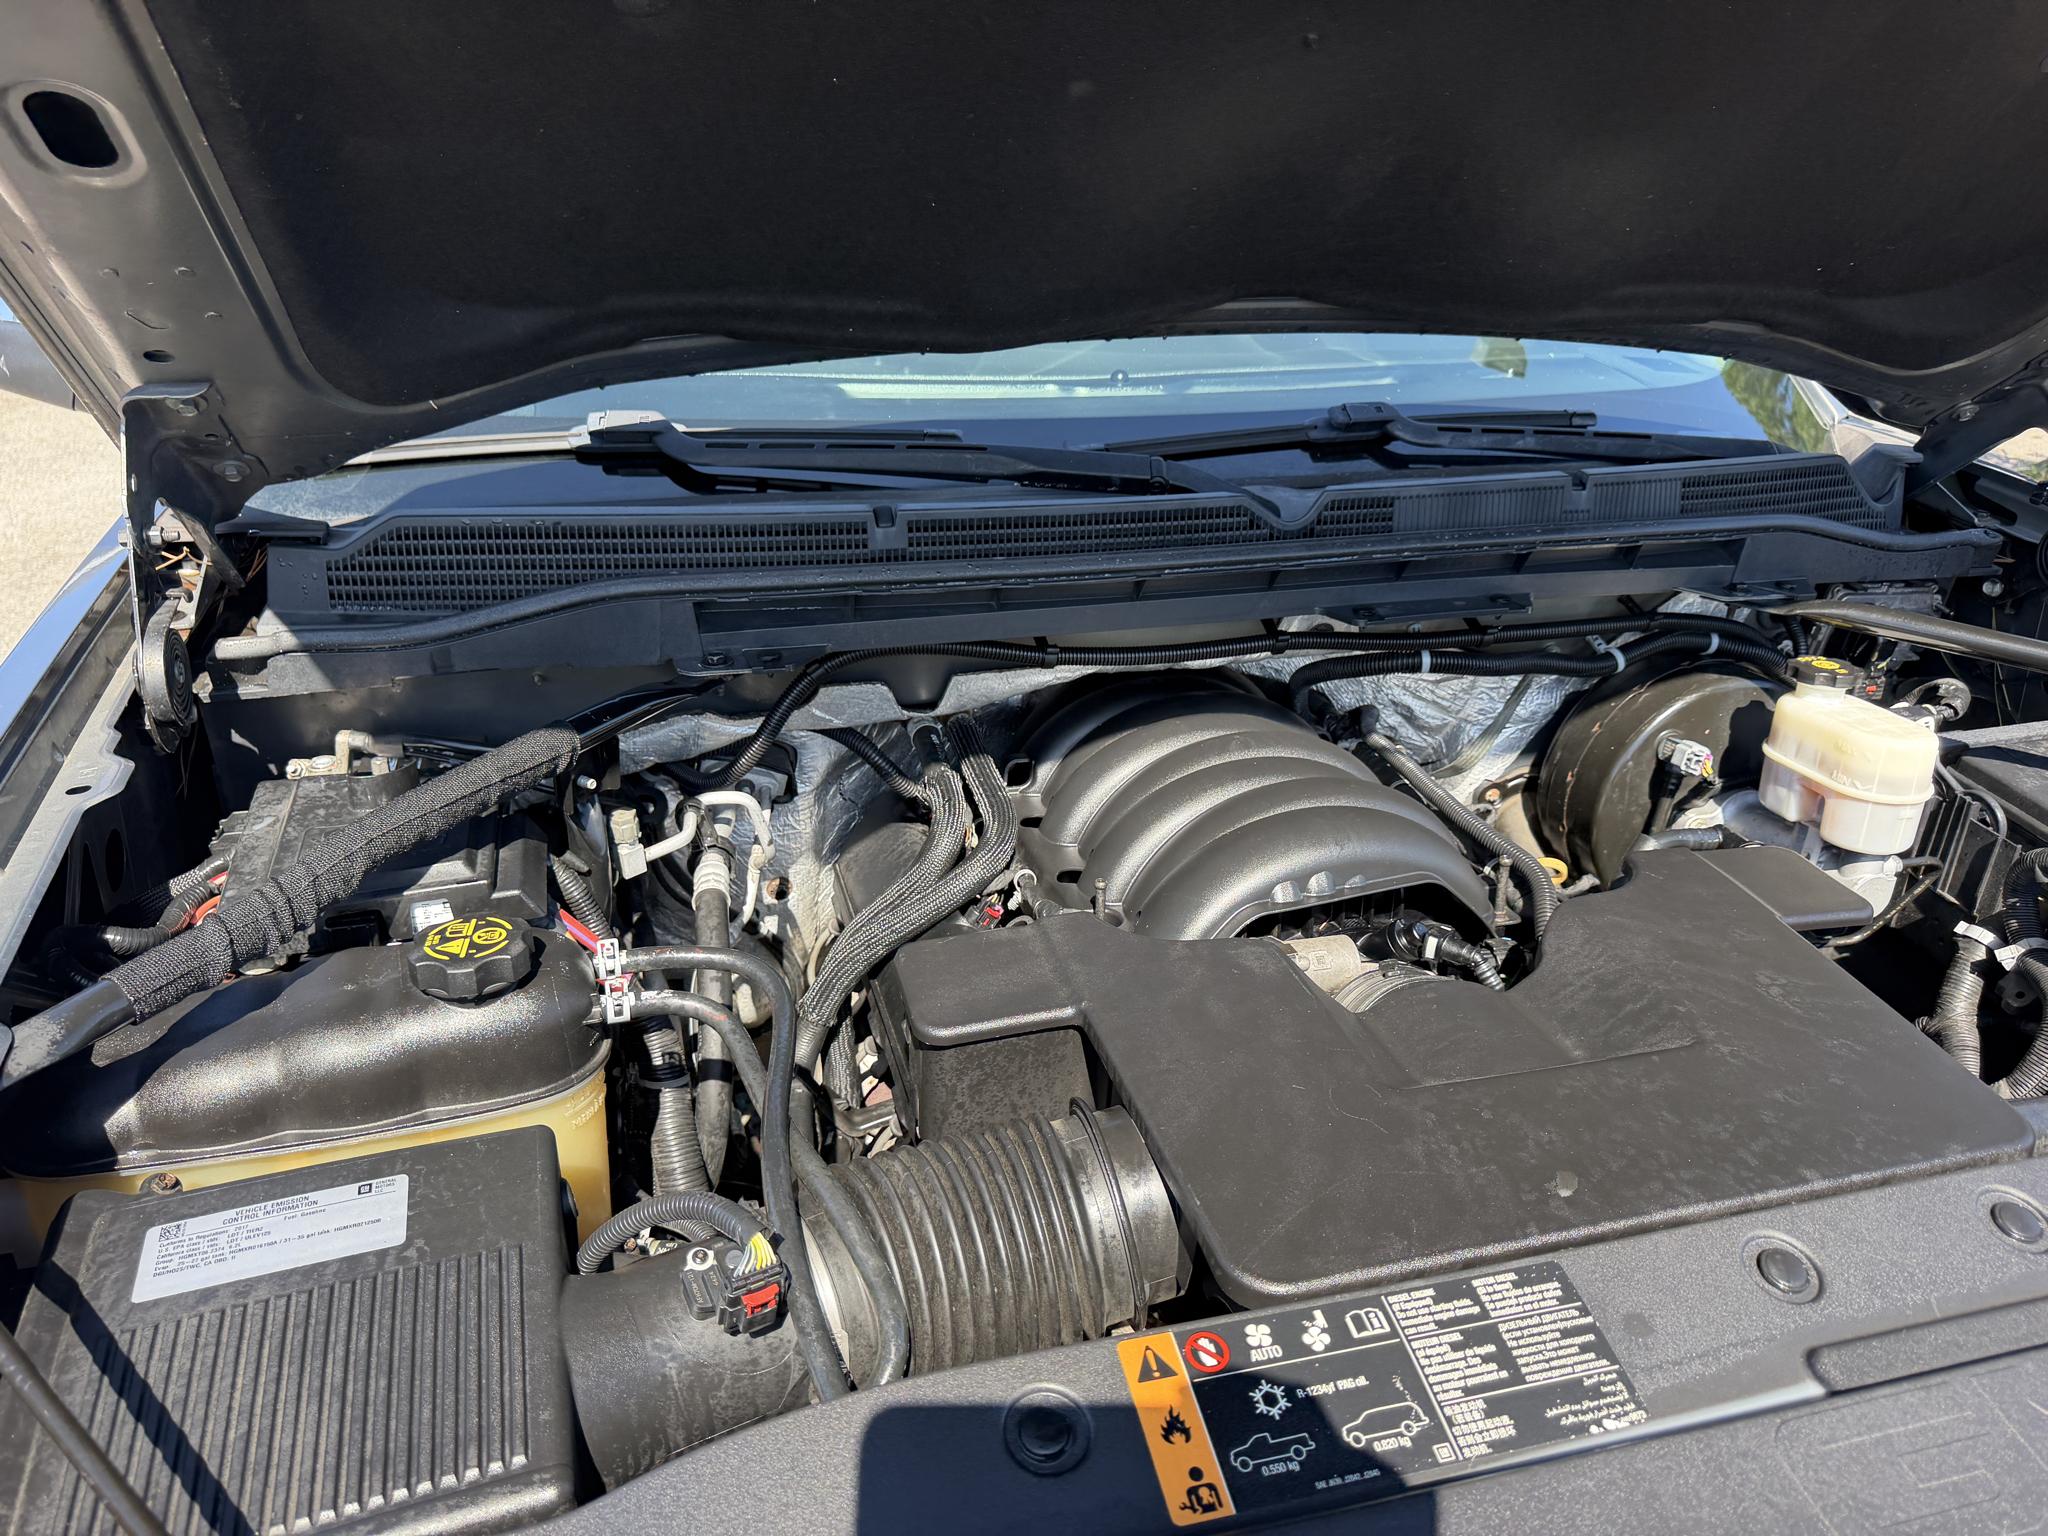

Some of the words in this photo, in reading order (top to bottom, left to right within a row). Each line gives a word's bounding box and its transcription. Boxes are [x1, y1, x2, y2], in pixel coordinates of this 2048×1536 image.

[223, 1213, 259, 1224] CONTROL
[263, 1201, 319, 1215] INFORMATION
[236, 1205, 267, 1215] VEHICLE
[272, 1196, 310, 1208] EMISSION
[1251, 1346, 1283, 1362] AUTO
[1298, 1382, 1336, 1397] R-1234yf
[1337, 1379, 1356, 1390] PAG
[1374, 1438, 1399, 1452] 0.820
[1398, 1437, 1412, 1448] kg
[1262, 1463, 1287, 1476] 0.550
[1287, 1462, 1300, 1472] kg
